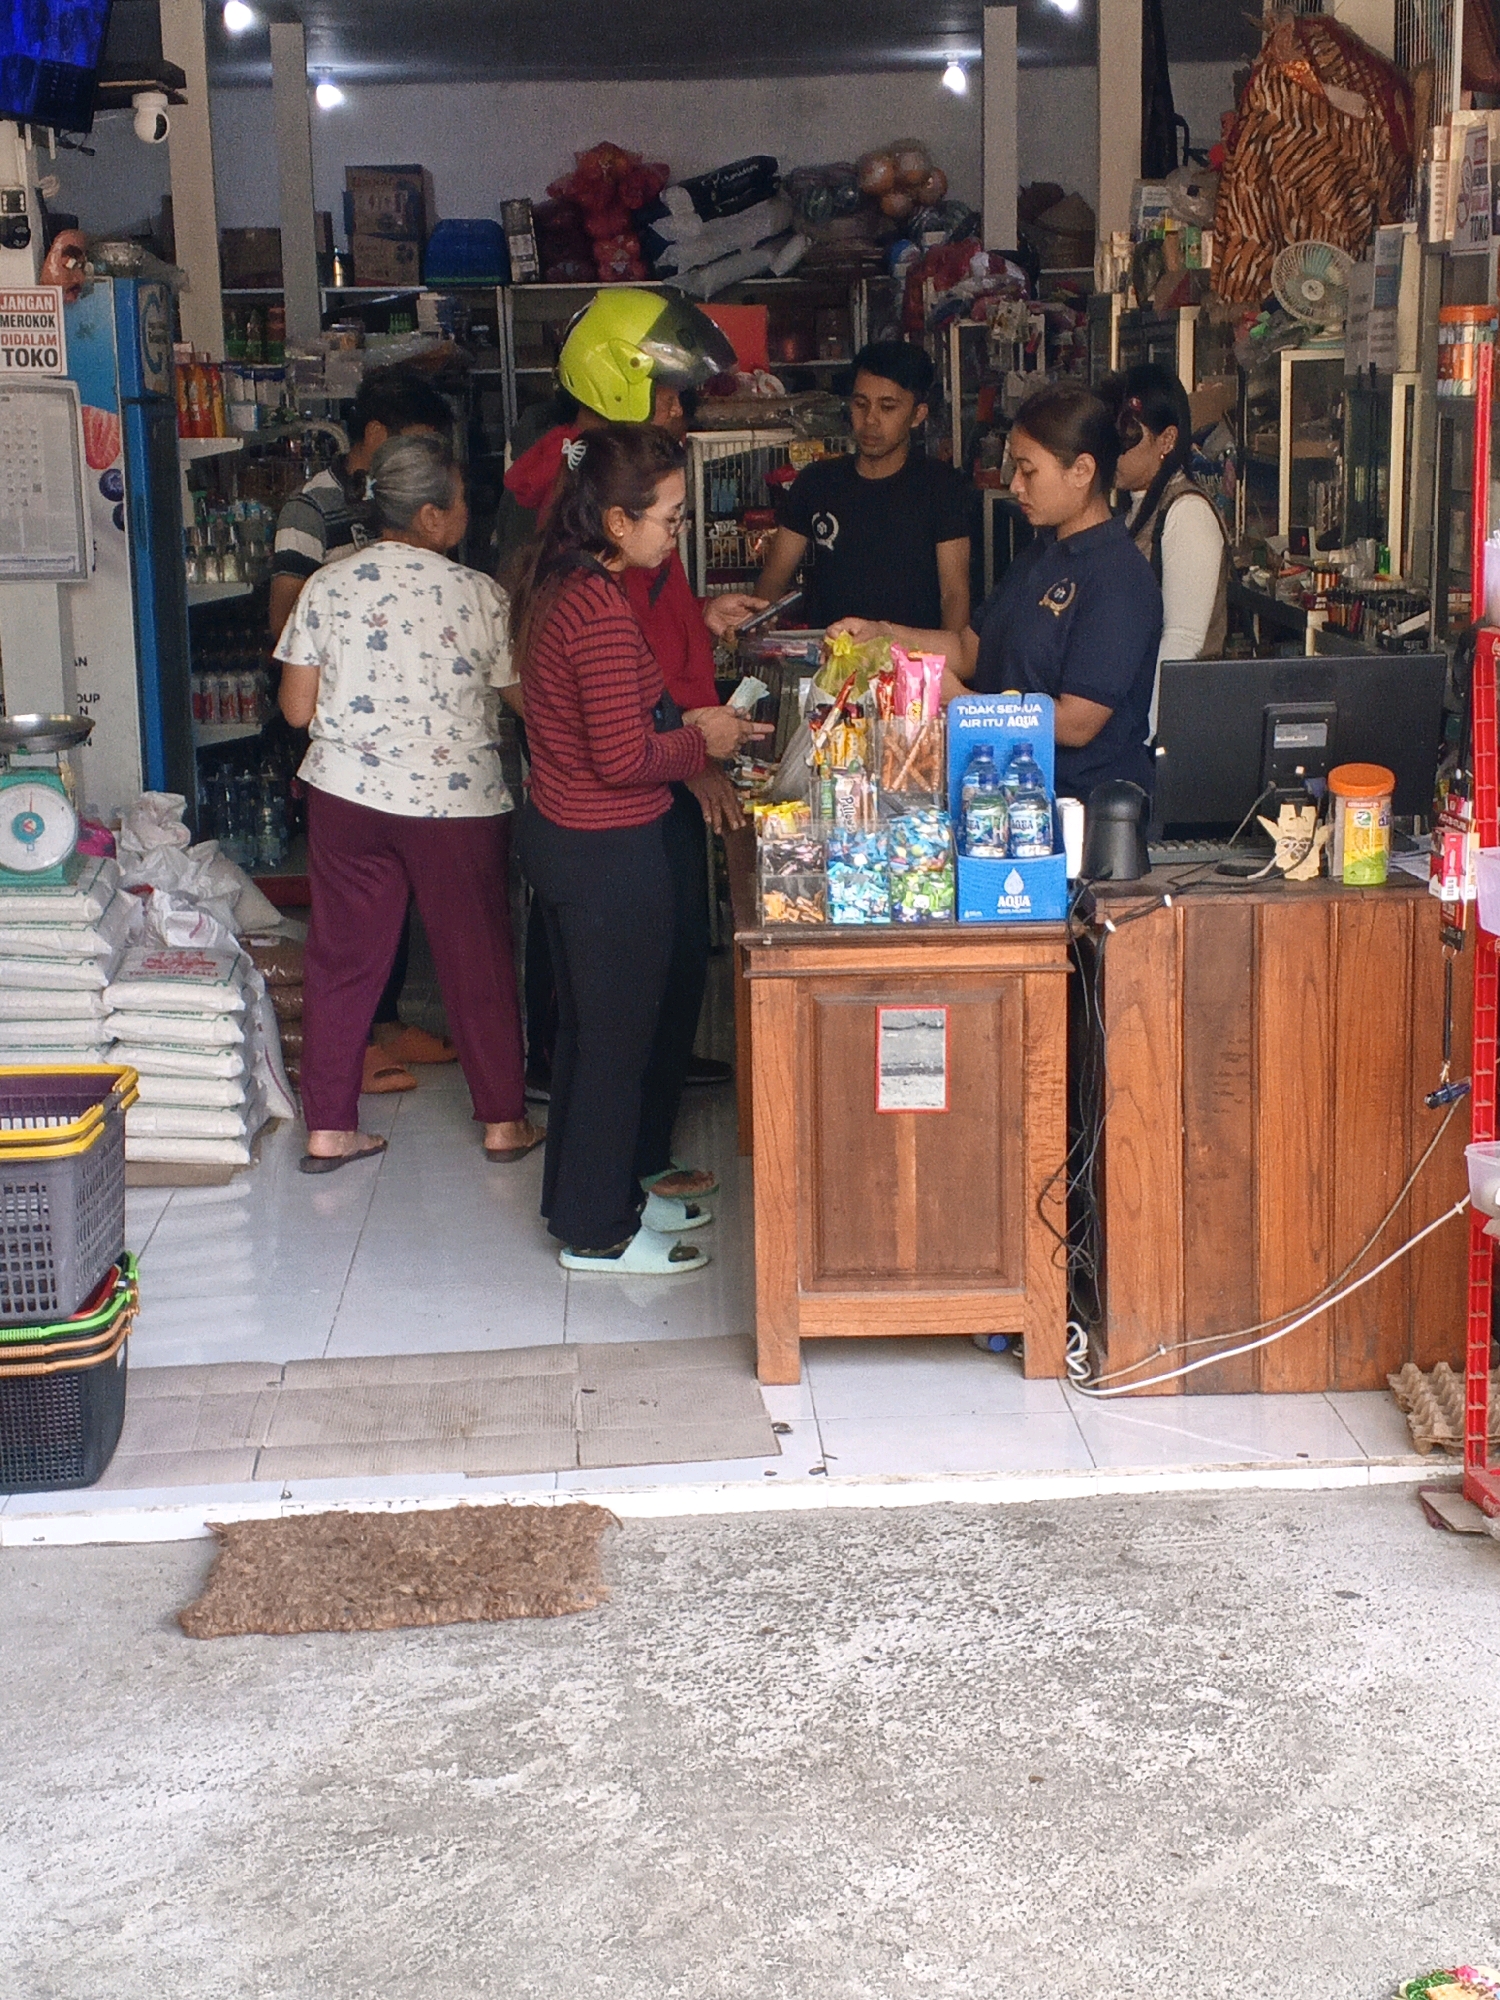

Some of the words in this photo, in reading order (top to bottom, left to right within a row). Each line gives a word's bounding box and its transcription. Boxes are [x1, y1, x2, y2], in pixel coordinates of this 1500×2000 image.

[0, 295, 54, 311] JANGAN
[0, 314, 55, 328] MEROKOK
[1, 333, 57, 346] DIDALAM
[1, 348, 58, 368] TOKO
[957, 704, 995, 715] TIDAK
[997, 703, 1042, 714] SEMUA
[959, 718, 981, 728] AIR
[983, 718, 1003, 727] ITU
[1007, 716, 1039, 728] AQUA
[997, 895, 1032, 909] AQUA
